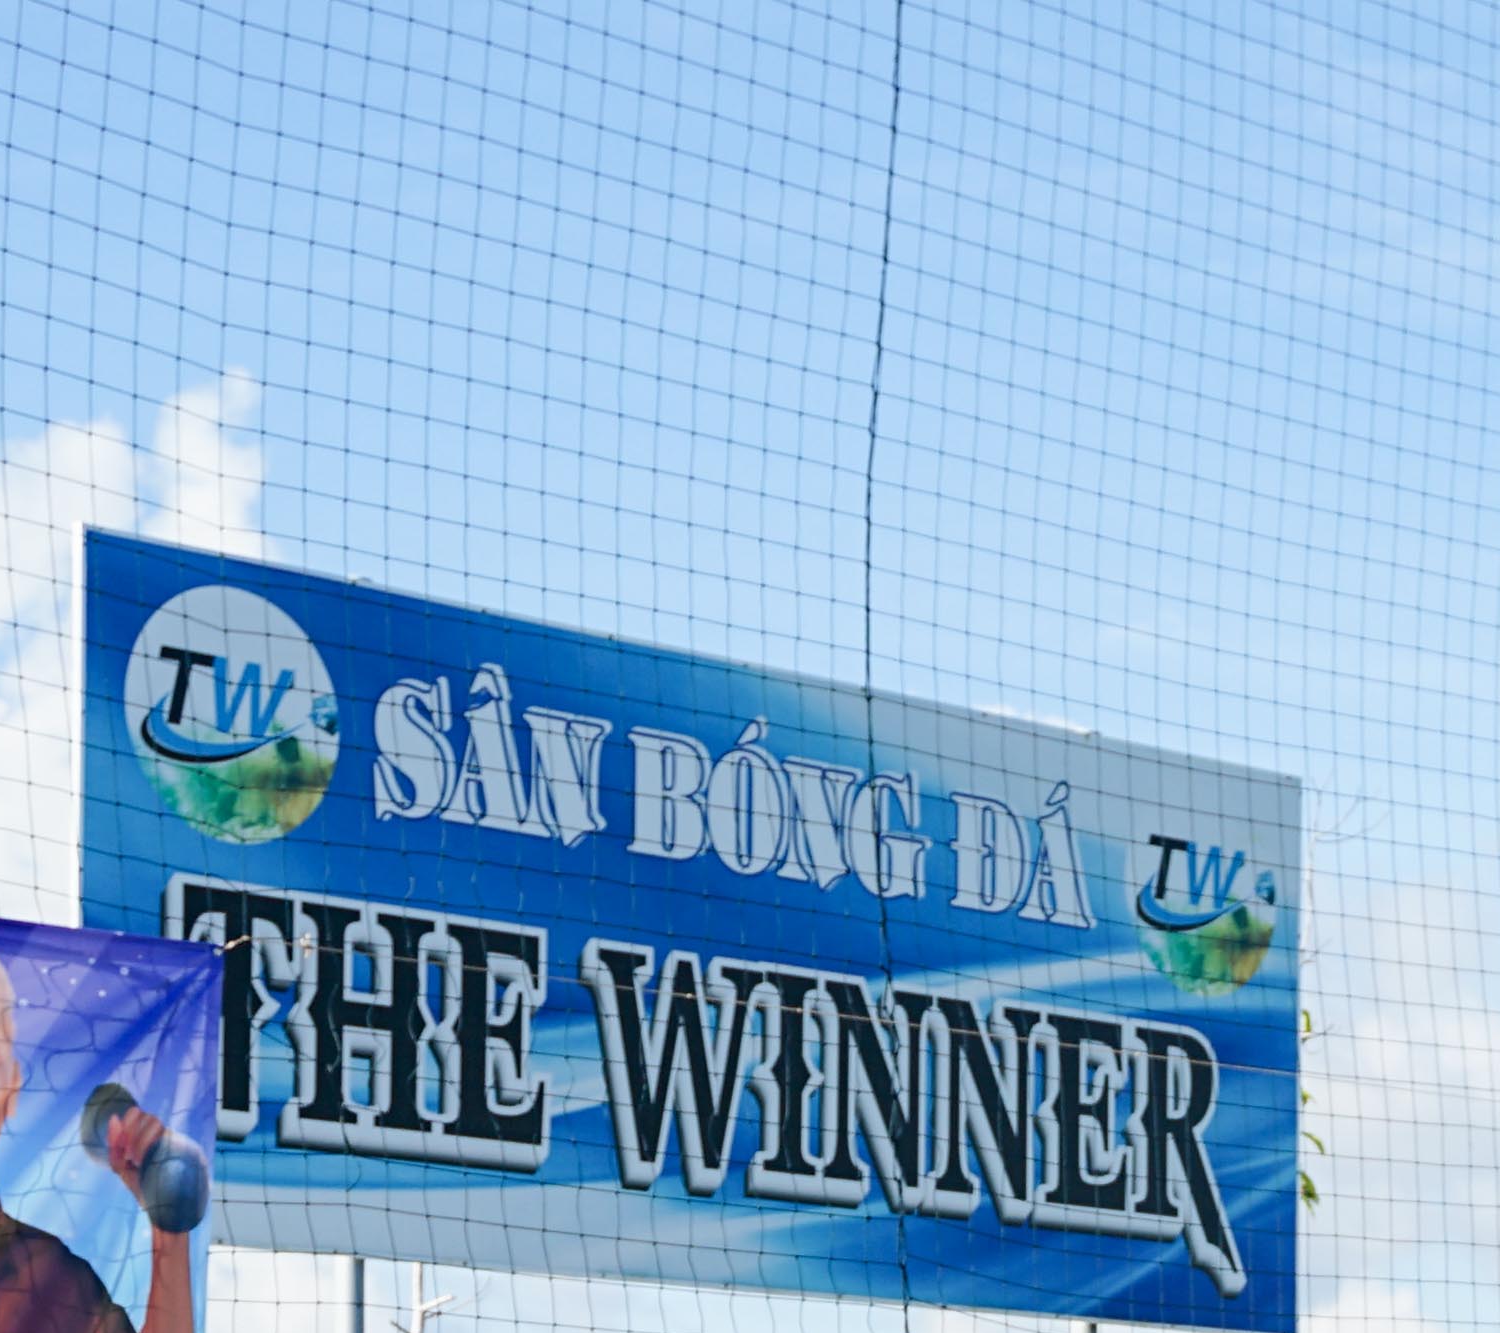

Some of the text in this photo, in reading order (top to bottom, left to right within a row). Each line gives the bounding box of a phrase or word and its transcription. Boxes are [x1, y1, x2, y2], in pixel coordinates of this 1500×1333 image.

[159, 645, 294, 736] TW
[373, 660, 1095, 930] SÂN BÓNG ĐÁ
[1147, 834, 1245, 904] TW
[162, 873, 1246, 1299] THE WINNER
